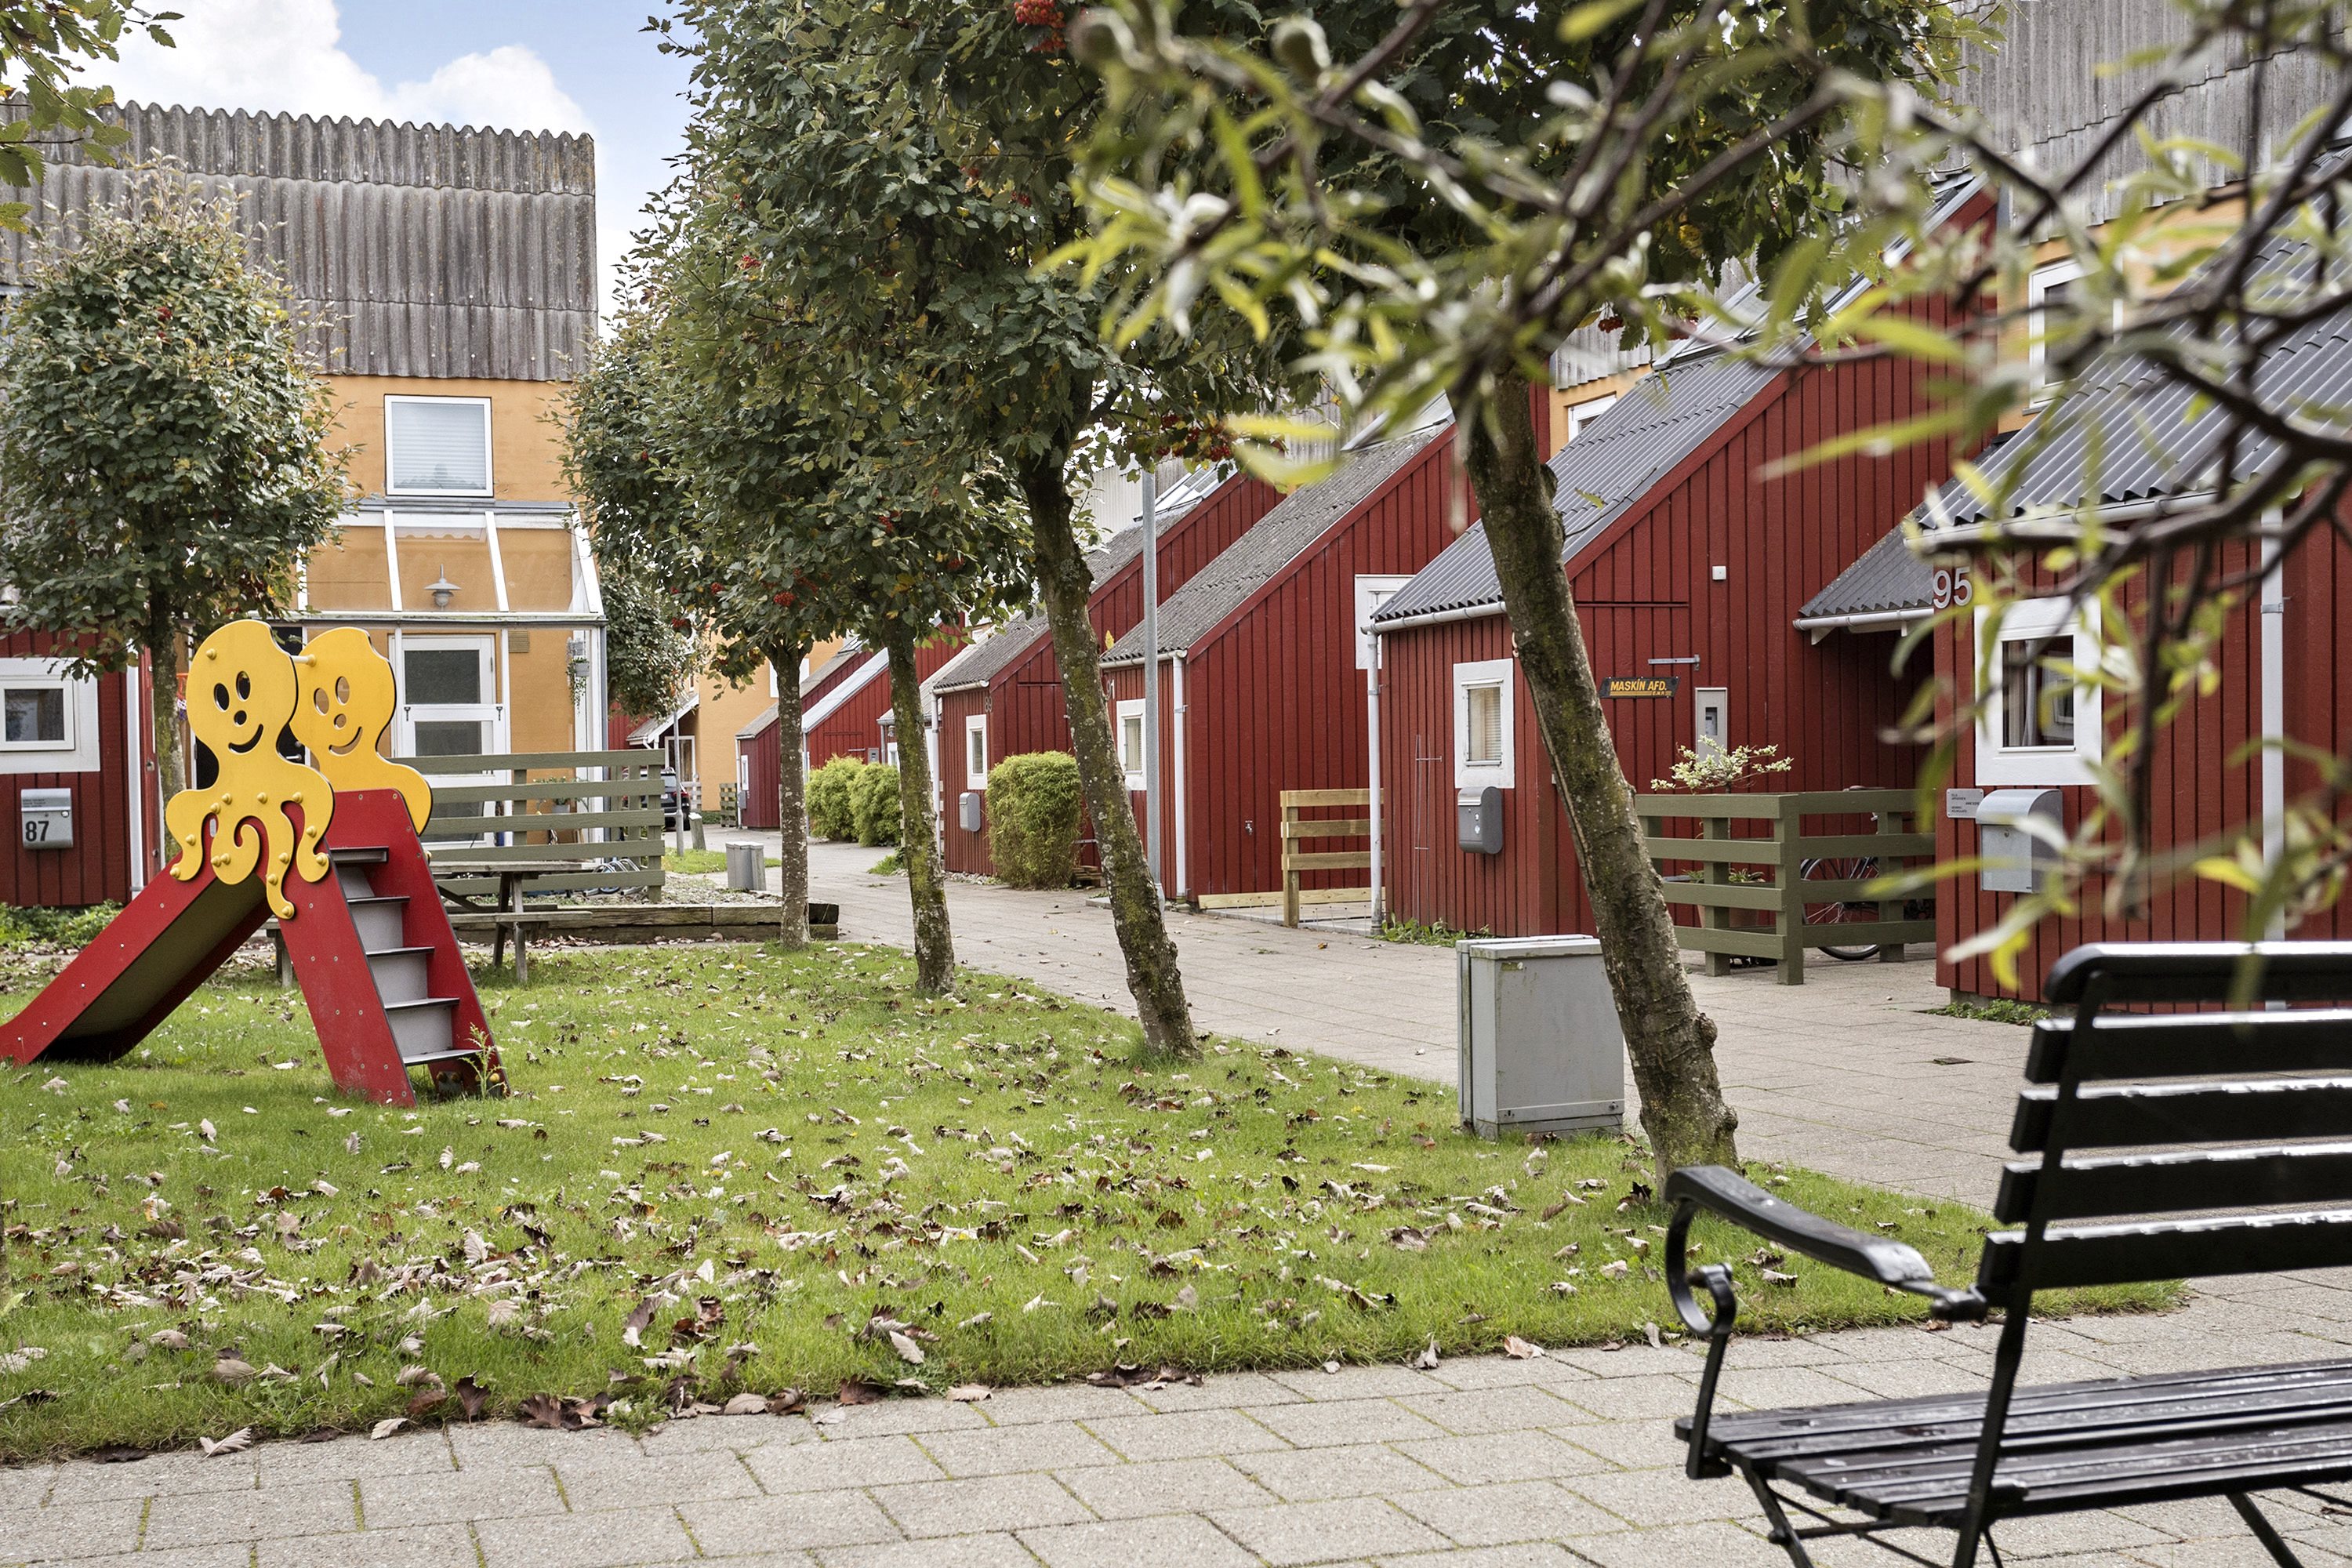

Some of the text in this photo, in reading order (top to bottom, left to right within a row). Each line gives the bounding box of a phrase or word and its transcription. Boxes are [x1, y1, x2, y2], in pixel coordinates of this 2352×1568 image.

[1933, 566, 1973, 609] 95
[1647, 681, 1667, 691] AFD.
[985, 696, 993, 713] 89
[25, 820, 49, 842] 87
